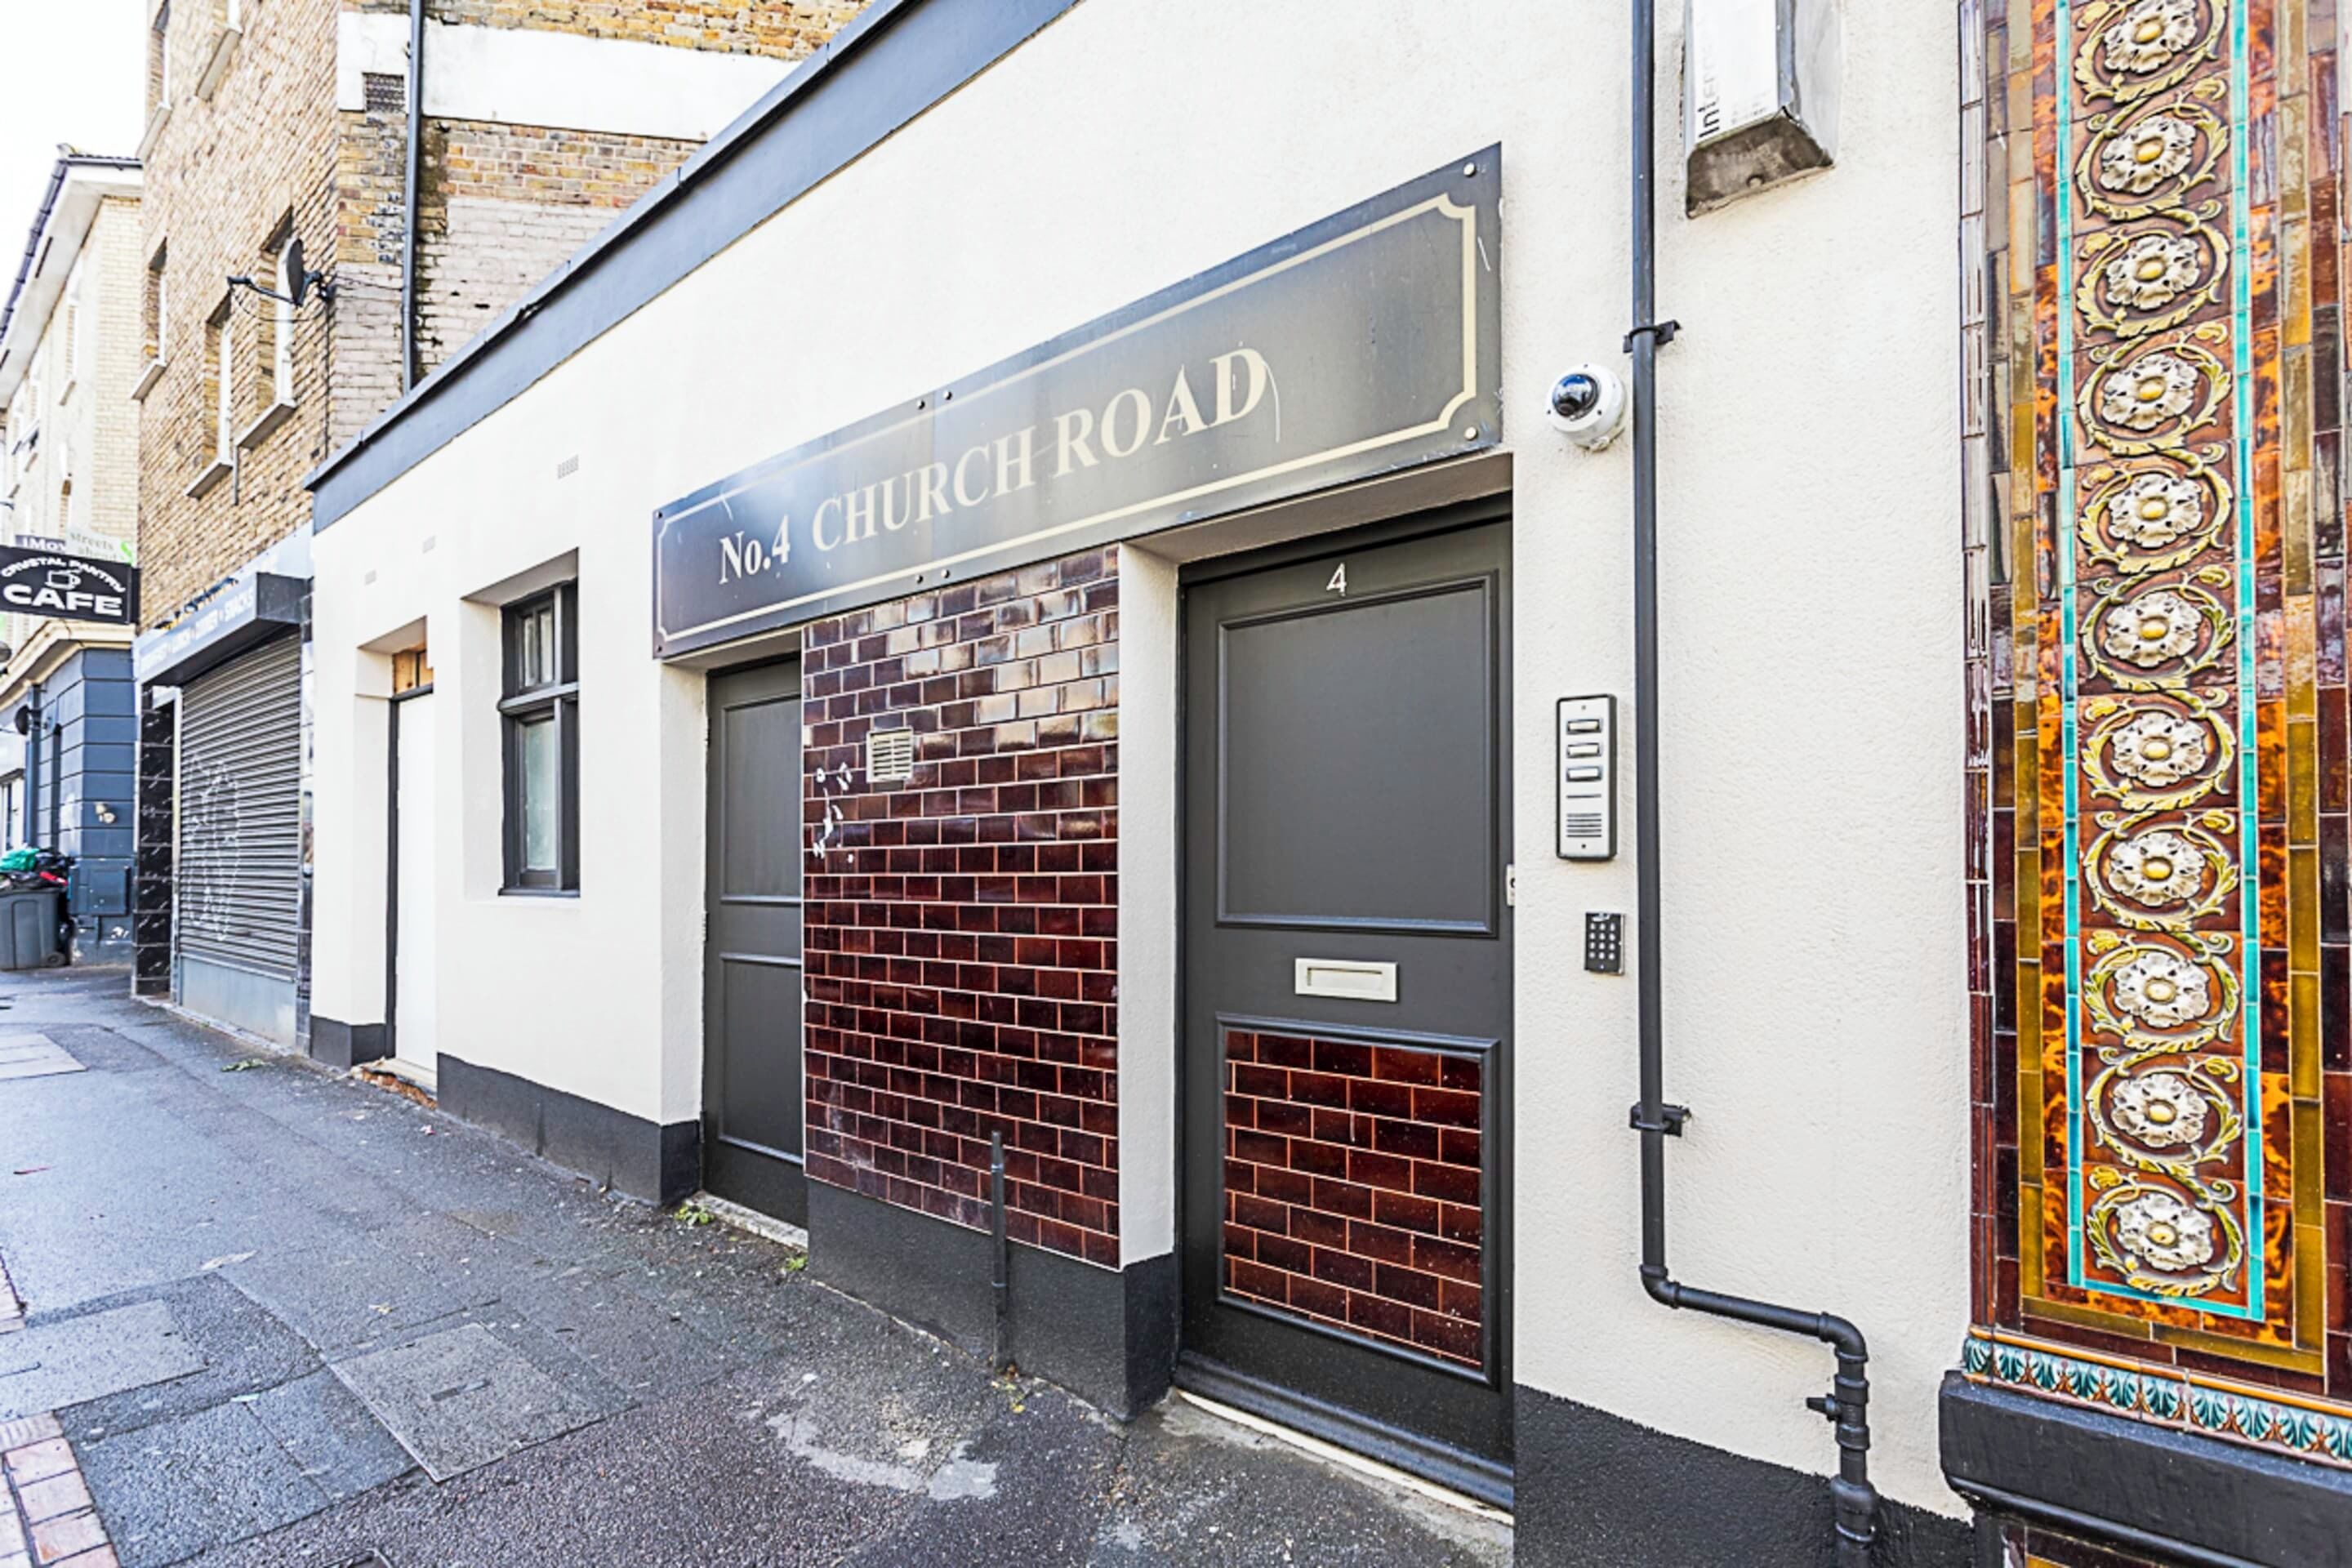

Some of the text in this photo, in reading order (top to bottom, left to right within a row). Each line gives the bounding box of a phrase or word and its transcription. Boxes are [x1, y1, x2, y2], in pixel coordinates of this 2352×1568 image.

[719, 349, 1267, 584] No.4 CHURCH ROAD
[70, 532, 114, 550] streets
[1, 557, 126, 592] CRYSTAL PANTRY
[1326, 563, 1347, 596] 4
[3, 584, 122, 616] CAFE
